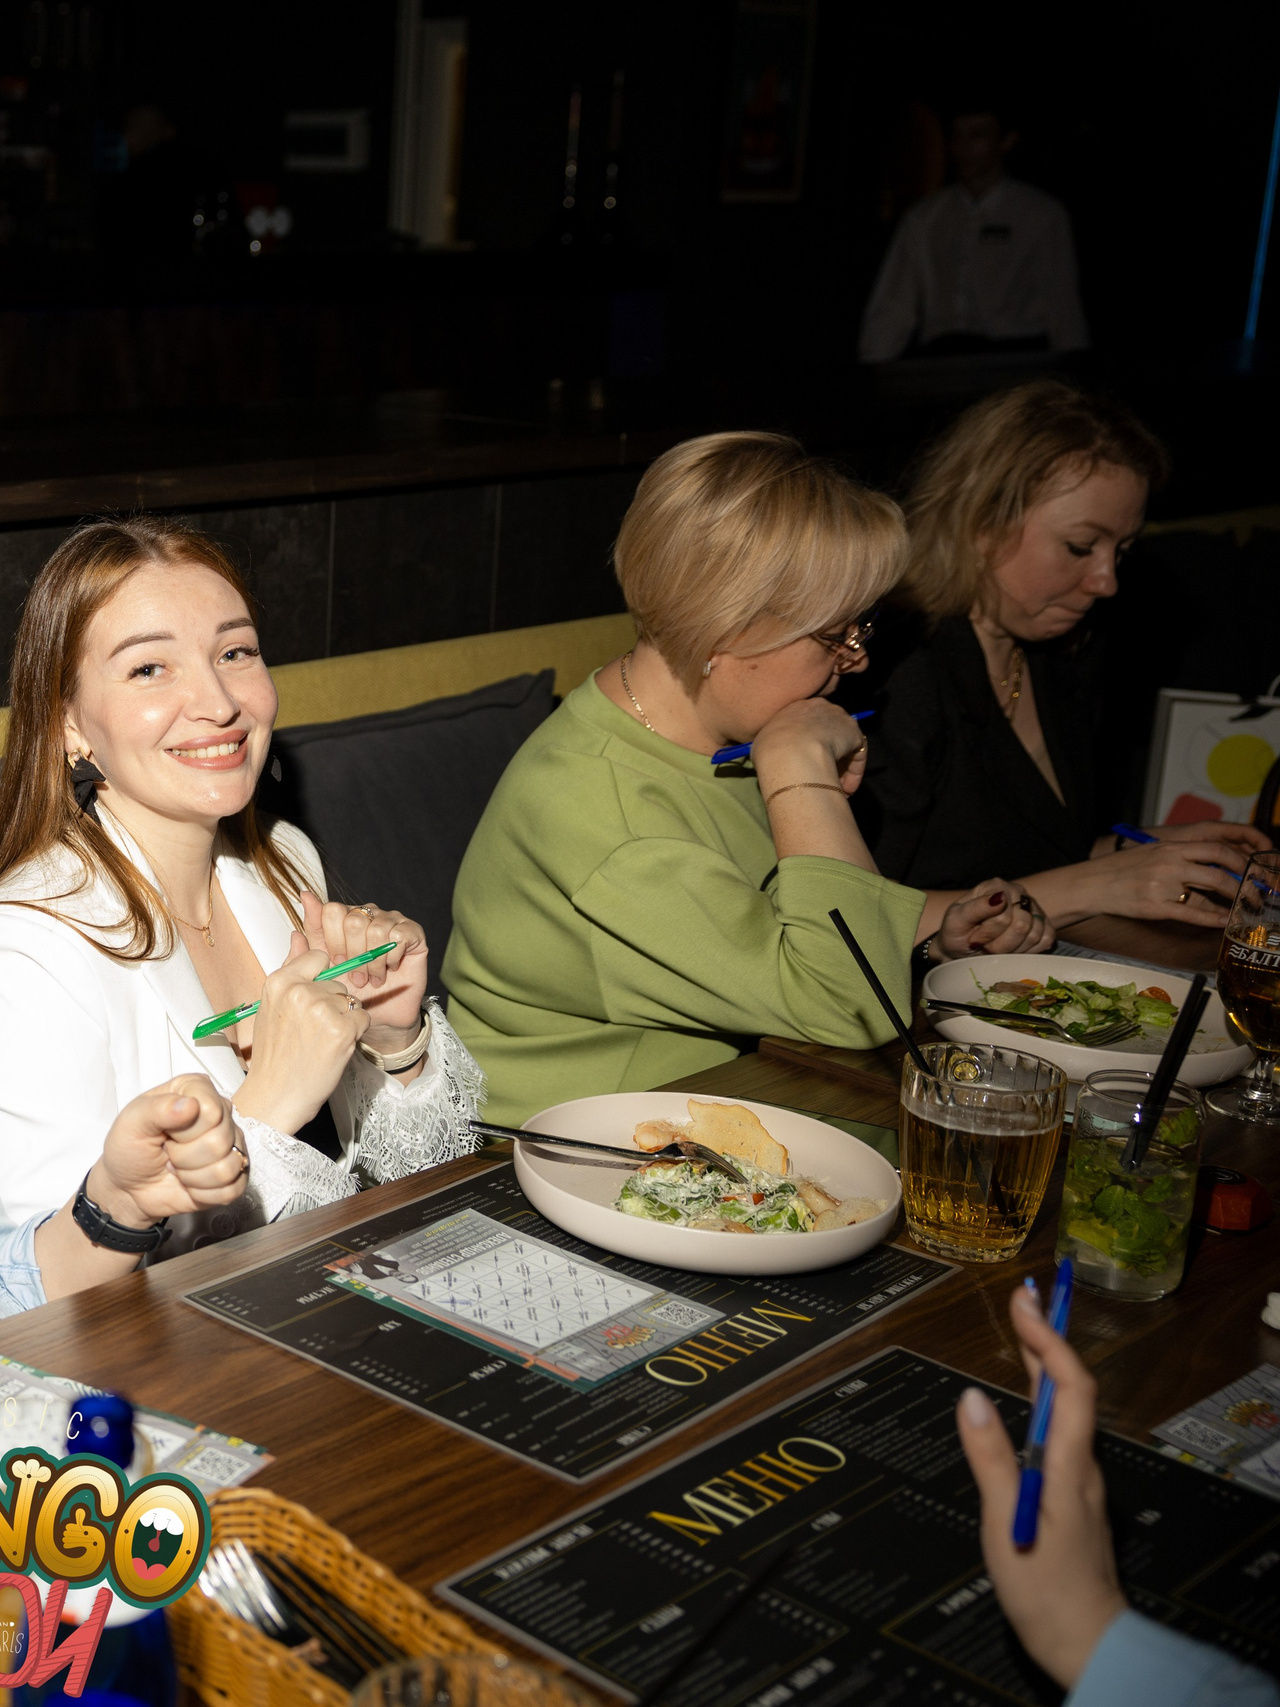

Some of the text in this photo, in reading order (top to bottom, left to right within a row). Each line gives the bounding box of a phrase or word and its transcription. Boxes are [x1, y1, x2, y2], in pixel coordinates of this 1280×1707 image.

[459, 1231, 512, 1260] АЛЕКСАНДР
[645, 1299, 816, 1386] МЕНЮ
[646, 1437, 846, 1546] МЕНЮ
